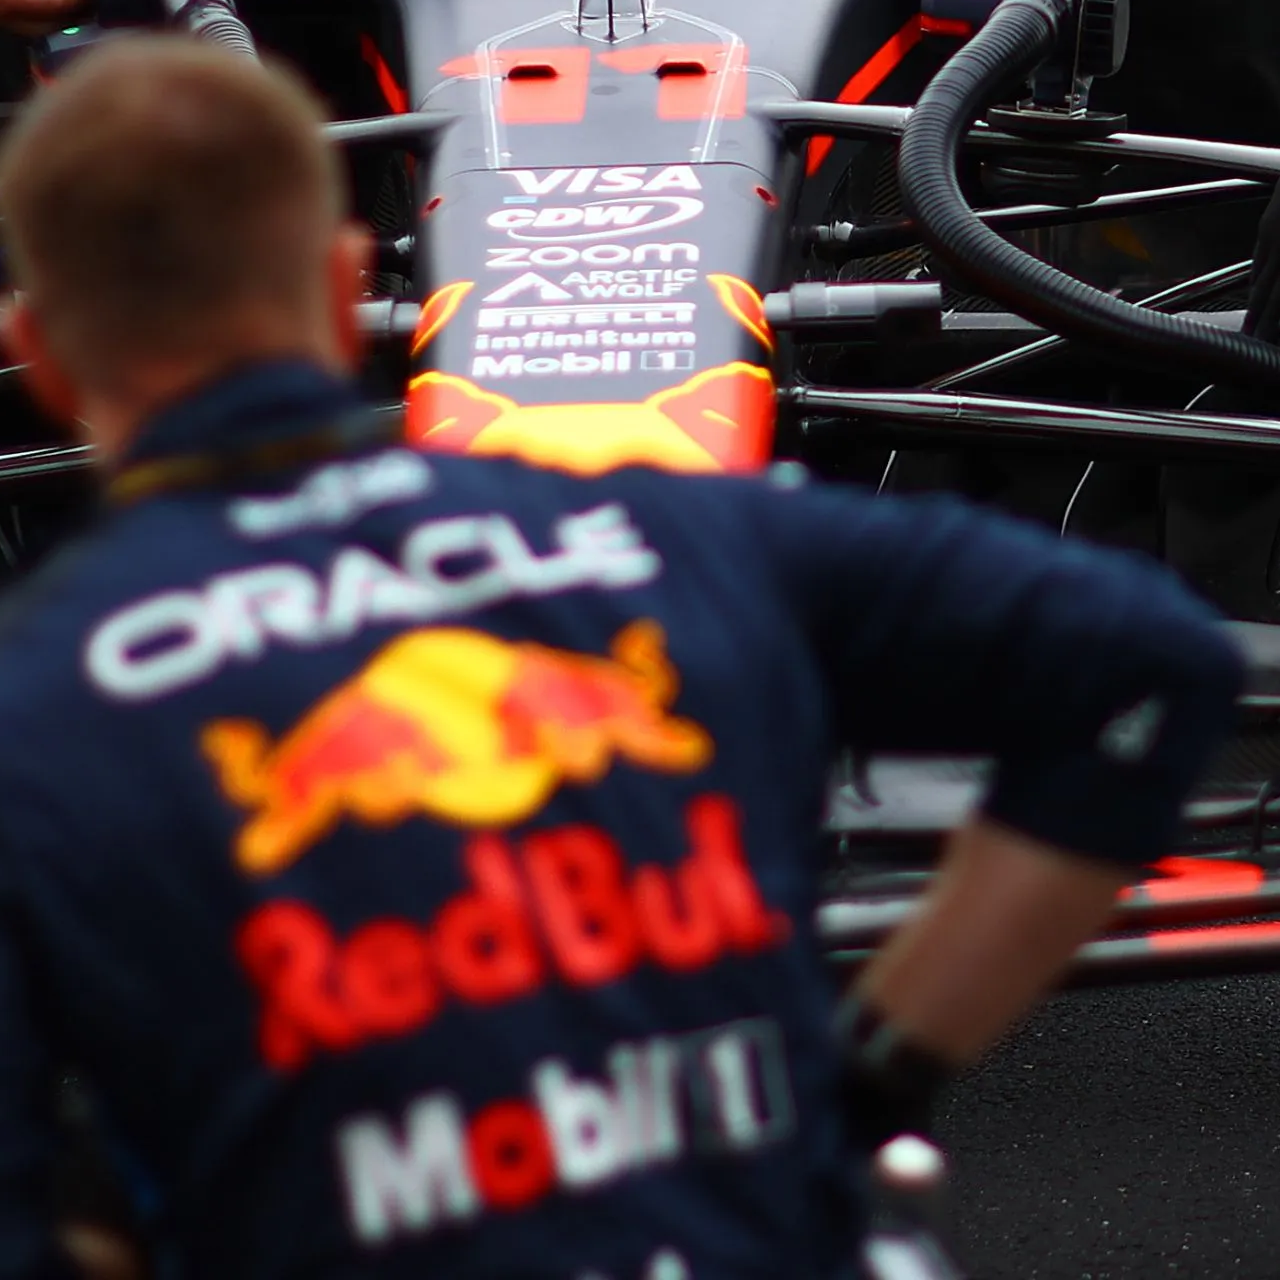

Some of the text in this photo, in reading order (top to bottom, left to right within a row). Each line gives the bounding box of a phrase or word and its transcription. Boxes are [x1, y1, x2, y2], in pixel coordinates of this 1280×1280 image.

[496, 166, 703, 195] VISA
[561, 268, 698, 285] ARCTIC
[579, 282, 685, 298] WOLF
[477, 302, 697, 328] PIRELLI
[475, 329, 697, 350] infinitum
[472, 350, 632, 377] Mobil
[86, 505, 661, 700] ORACLE
